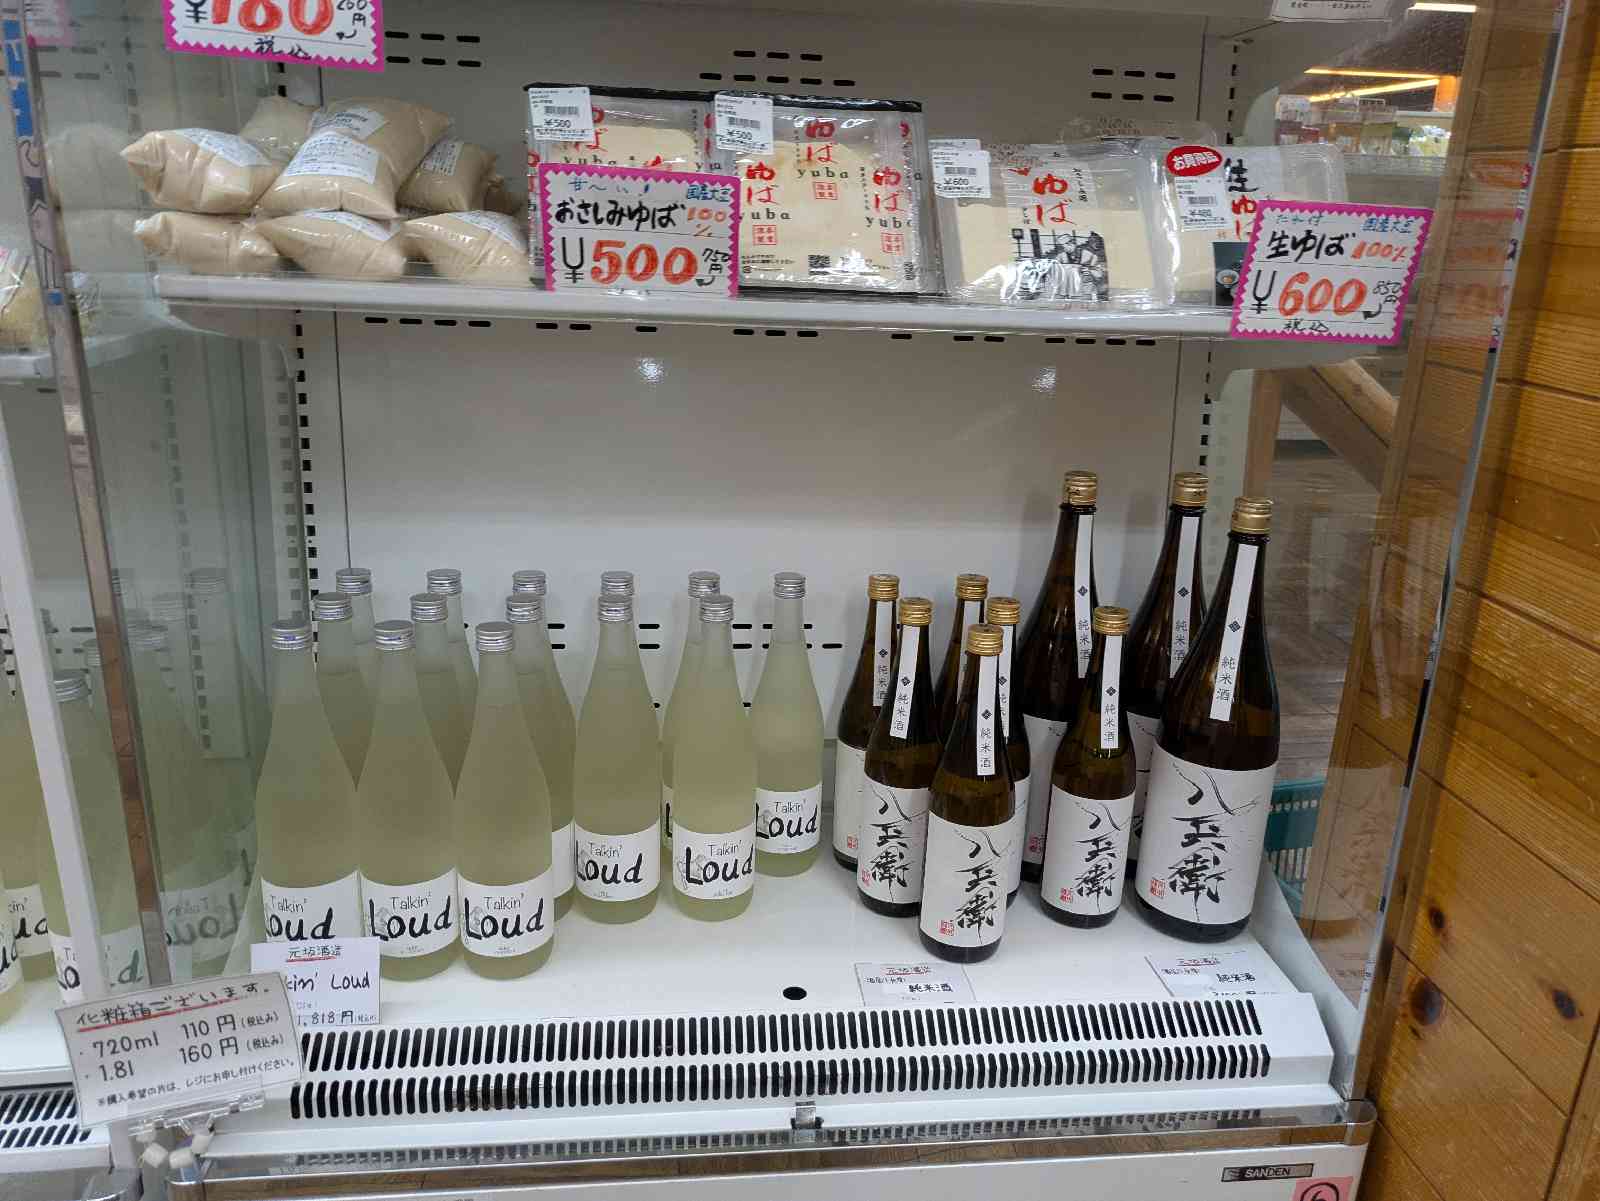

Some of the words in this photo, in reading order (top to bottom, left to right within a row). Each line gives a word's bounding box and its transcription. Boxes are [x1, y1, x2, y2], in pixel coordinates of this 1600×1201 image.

[352, 13, 367, 27] 円
[744, 161, 779, 206] ゆば
[797, 167, 849, 179] yuba
[873, 166, 911, 213] ゆば
[1032, 173, 1076, 226] ゆば
[554, 197, 687, 231] おさしみゆば
[687, 206, 727, 222] 100
[740, 207, 792, 222] uba
[1266, 230, 1357, 262] 生ゆば
[1351, 240, 1407, 262] 100%
[709, 264, 723, 275] 円
[1216, 656, 1237, 702] 純米酒
[1103, 703, 1117, 742] 純米酒
[775, 799, 807, 814] Talkin'
[756, 803, 818, 840] Loud
[588, 842, 623, 857] Talkin'
[708, 840, 743, 857] Talkin'
[684, 842, 753, 886] Loud
[391, 890, 433, 910] Talkin'
[484, 892, 526, 910] Talkin'
[265, 907, 336, 941] oud
[368, 895, 452, 942] Loud
[464, 897, 545, 941] Loud
[288, 945, 343, 958] 元坂酒造
[331, 971, 370, 990] Loud
[75, 982, 270, 1026] 化粧箱ございます。
[1244, 1167, 1291, 1178] SANDEN
